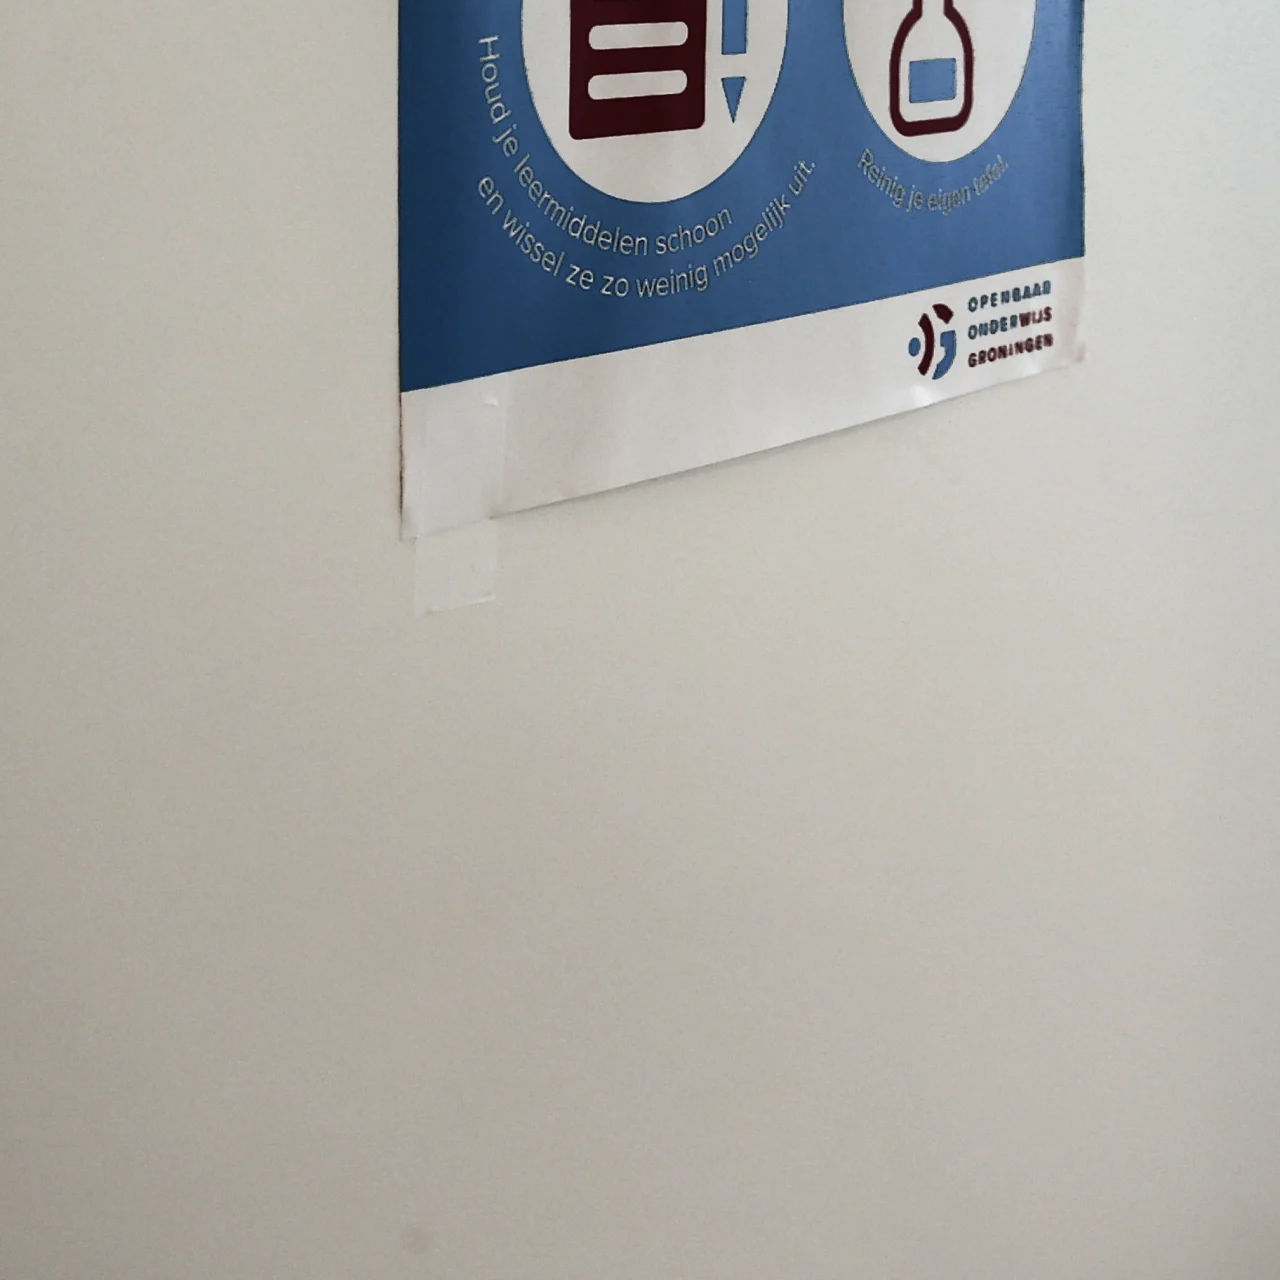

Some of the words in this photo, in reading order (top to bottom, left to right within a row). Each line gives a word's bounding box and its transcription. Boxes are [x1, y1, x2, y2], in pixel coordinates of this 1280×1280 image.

[478, 35, 513, 124] Houd
[492, 123, 519, 157] je
[513, 153, 648, 256] leermiddelen
[857, 147, 906, 208] Reinig
[905, 184, 926, 212] je
[478, 176, 504, 215] en
[501, 209, 565, 276] wissel
[565, 263, 594, 291] ze
[600, 274, 629, 298] zo
[636, 263, 708, 298] weinig
[713, 193, 791, 277] mogelijk
[788, 159, 816, 196] uit.
[655, 207, 732, 255] schoon
[967, 306, 1052, 339] ONDERWIJS
[967, 333, 1053, 368] GRONINGEN
